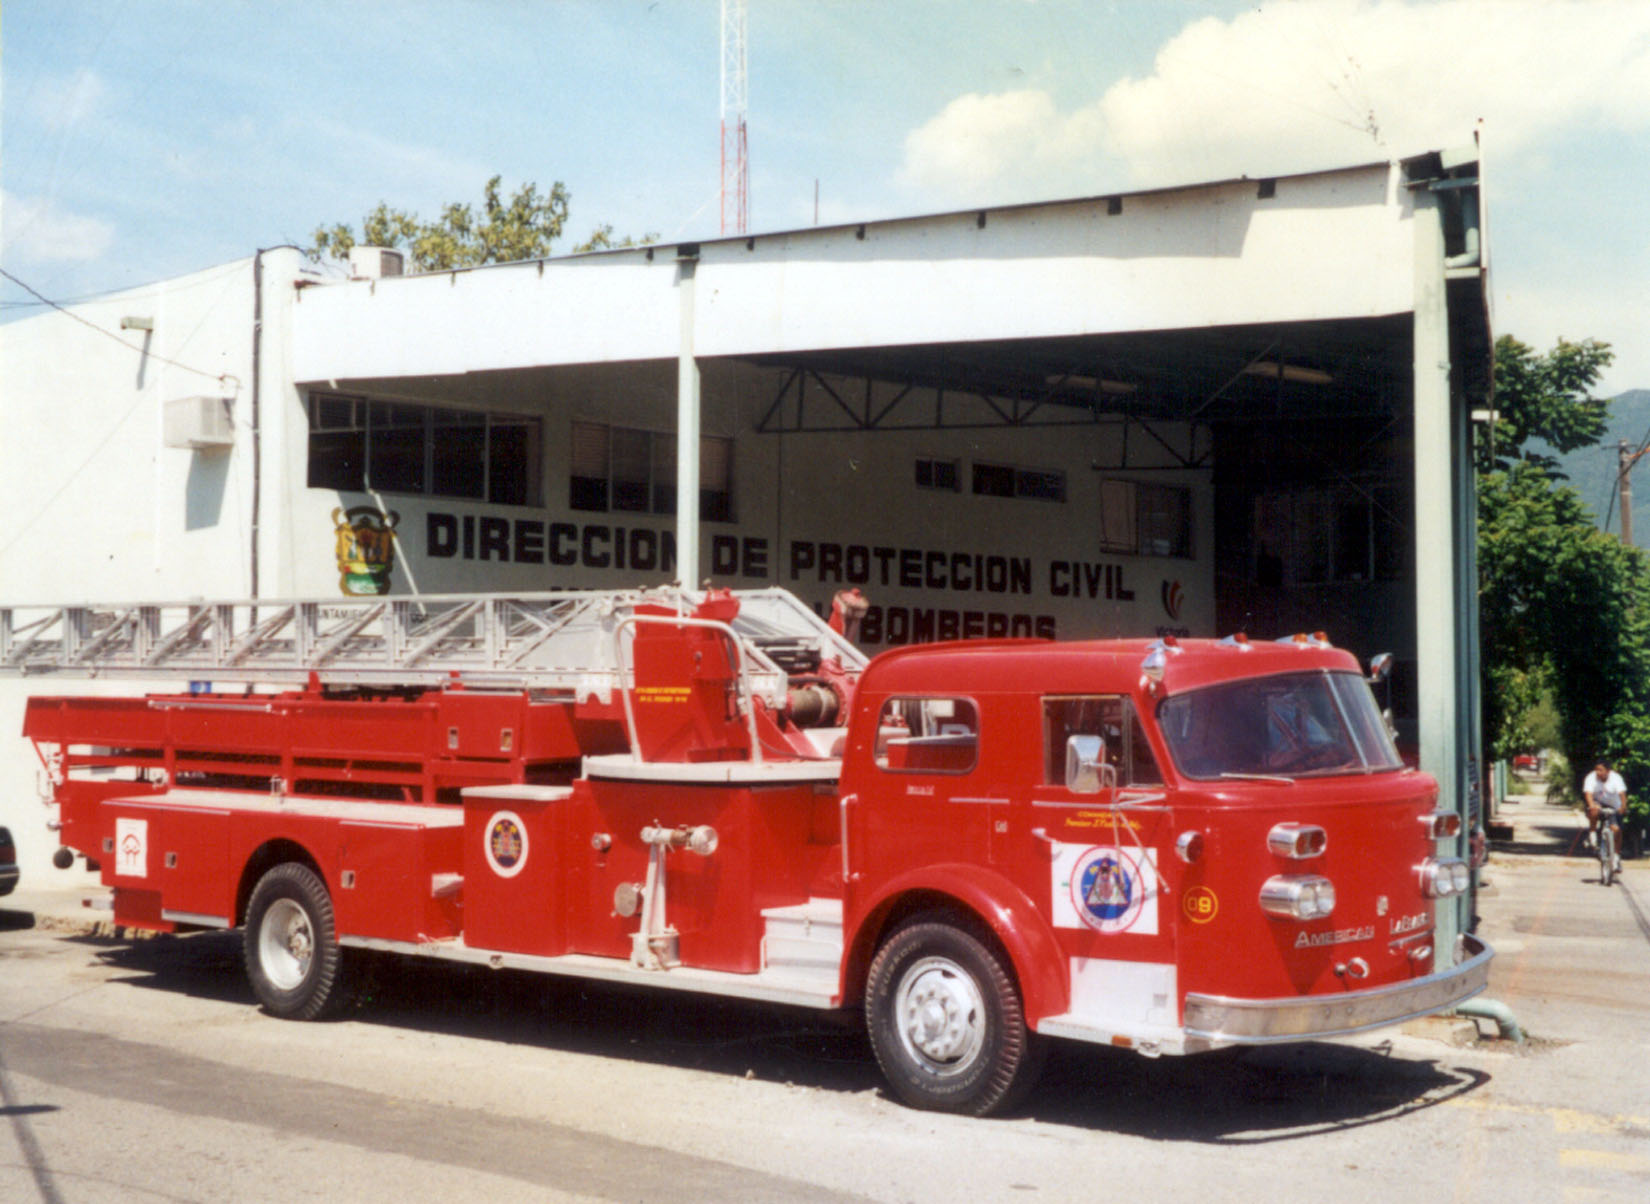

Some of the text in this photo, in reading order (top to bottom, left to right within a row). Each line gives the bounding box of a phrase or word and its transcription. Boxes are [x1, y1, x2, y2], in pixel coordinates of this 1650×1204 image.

[427, 512, 1134, 601] DIRECCION DE PROTECCION CIVIL
[860, 606, 1056, 644] BOMBEROS
